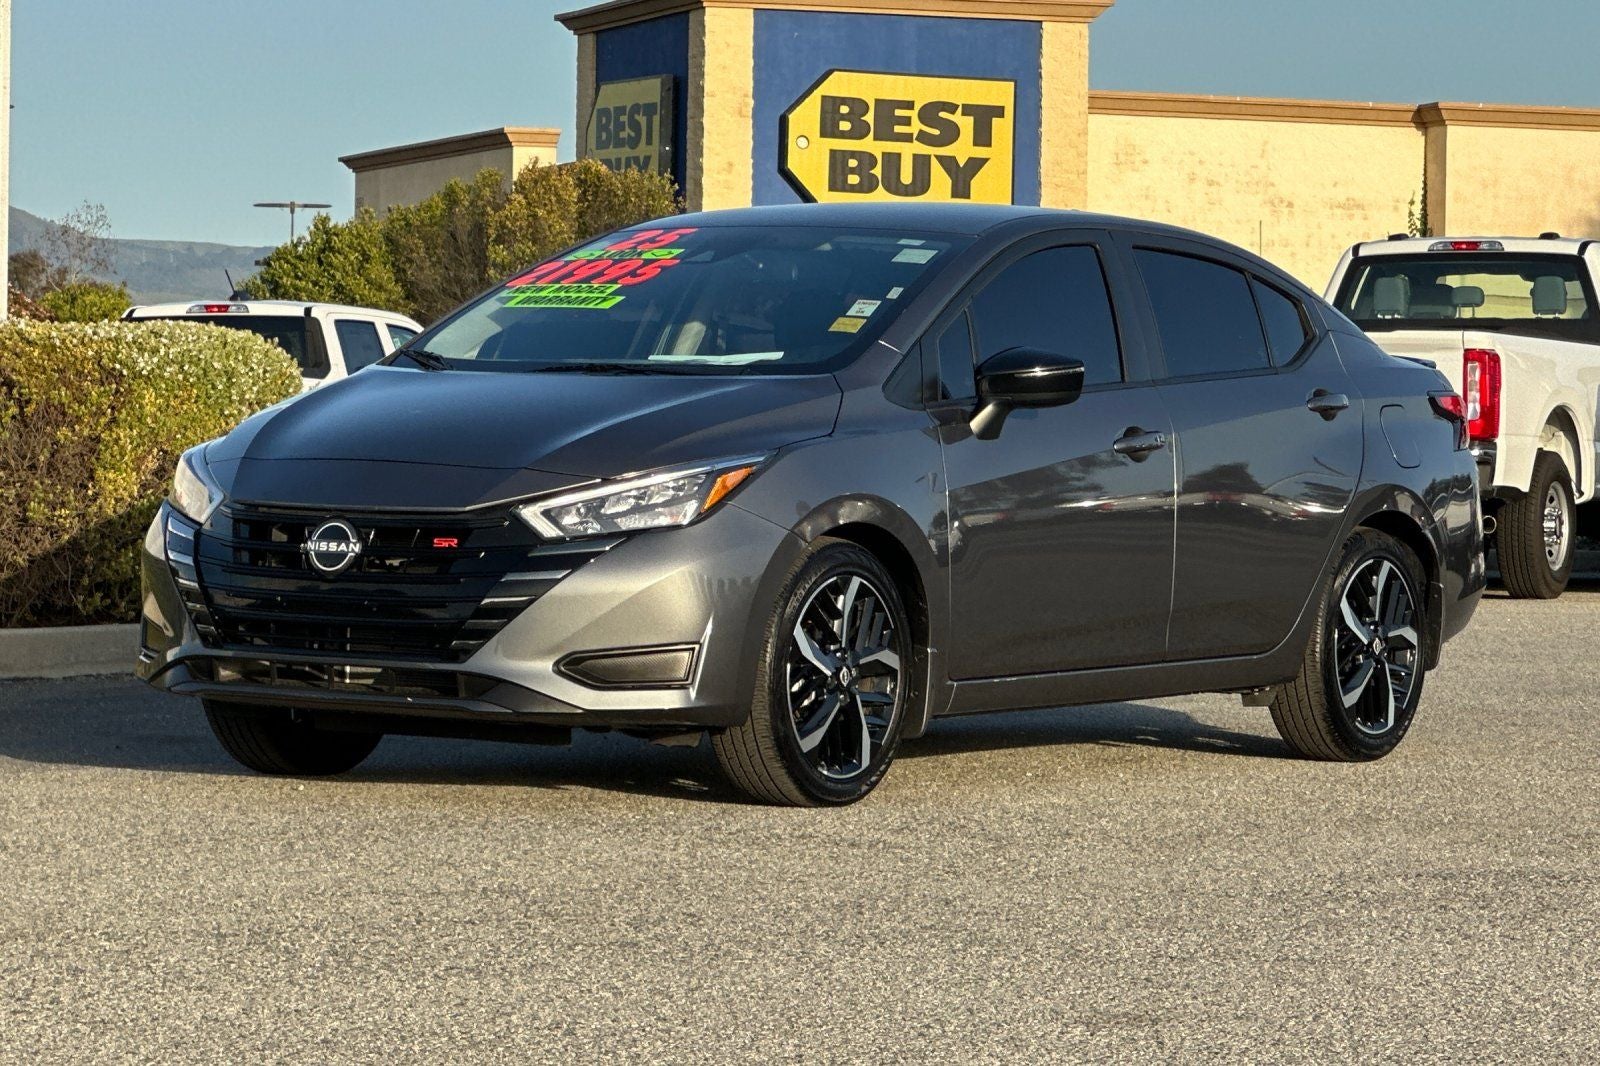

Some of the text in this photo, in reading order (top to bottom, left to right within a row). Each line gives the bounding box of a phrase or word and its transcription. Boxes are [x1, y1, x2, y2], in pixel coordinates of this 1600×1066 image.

[595, 102, 658, 150] BEST
[819, 95, 1005, 148] BEST
[828, 148, 990, 200] BUY
[604, 227, 699, 251] 25
[505, 258, 681, 286] 21995
[547, 285, 615, 295] MODEL
[307, 540, 360, 553] NISSAN
[432, 537, 458, 548] SR
